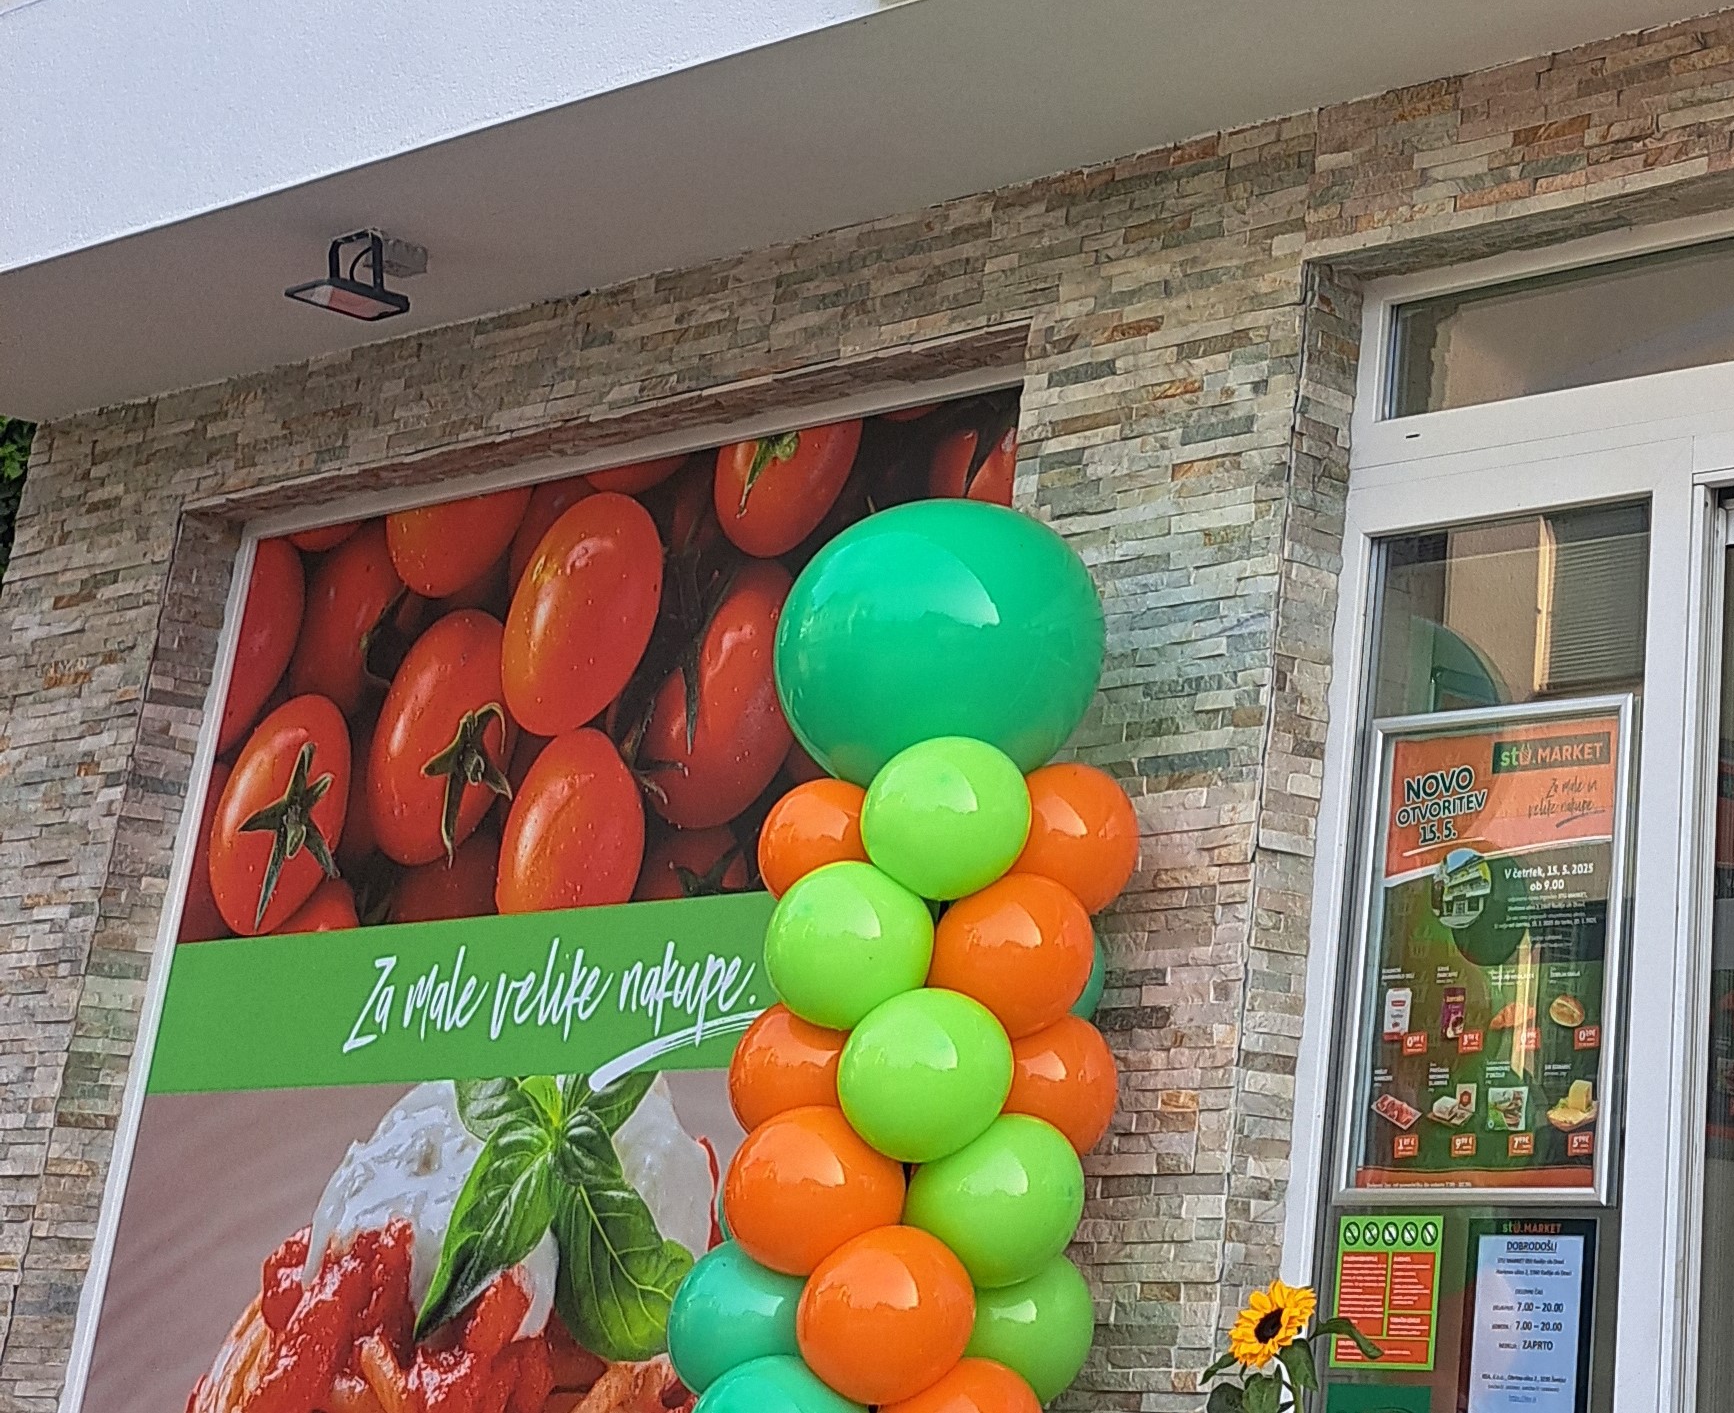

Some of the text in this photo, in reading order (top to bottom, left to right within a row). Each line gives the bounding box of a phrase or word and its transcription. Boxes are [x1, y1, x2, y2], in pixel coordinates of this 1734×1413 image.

[1538, 742, 1603, 764] MARKET
[1405, 766, 1474, 803] NOVO
[1396, 790, 1488, 826] OTVORITEV
[1419, 820, 1457, 845] 15. 5.
[1504, 869, 1512, 879] V
[1572, 863, 1594, 875] 2025
[1530, 879, 1565, 891] ob 9.00
[342, 937, 757, 1054] Za male velike nakupe.
[1524, 1223, 1562, 1234] MARKET
[1506, 1239, 1557, 1252] DOBRODOŠLI
[1516, 1301, 1534, 1313] 7.00
[1541, 1302, 1564, 1313] 20.00
[1515, 1320, 1532, 1331] 7.00
[1540, 1321, 1563, 1332] 20.00
[1522, 1339, 1554, 1352] ZAPRTO
